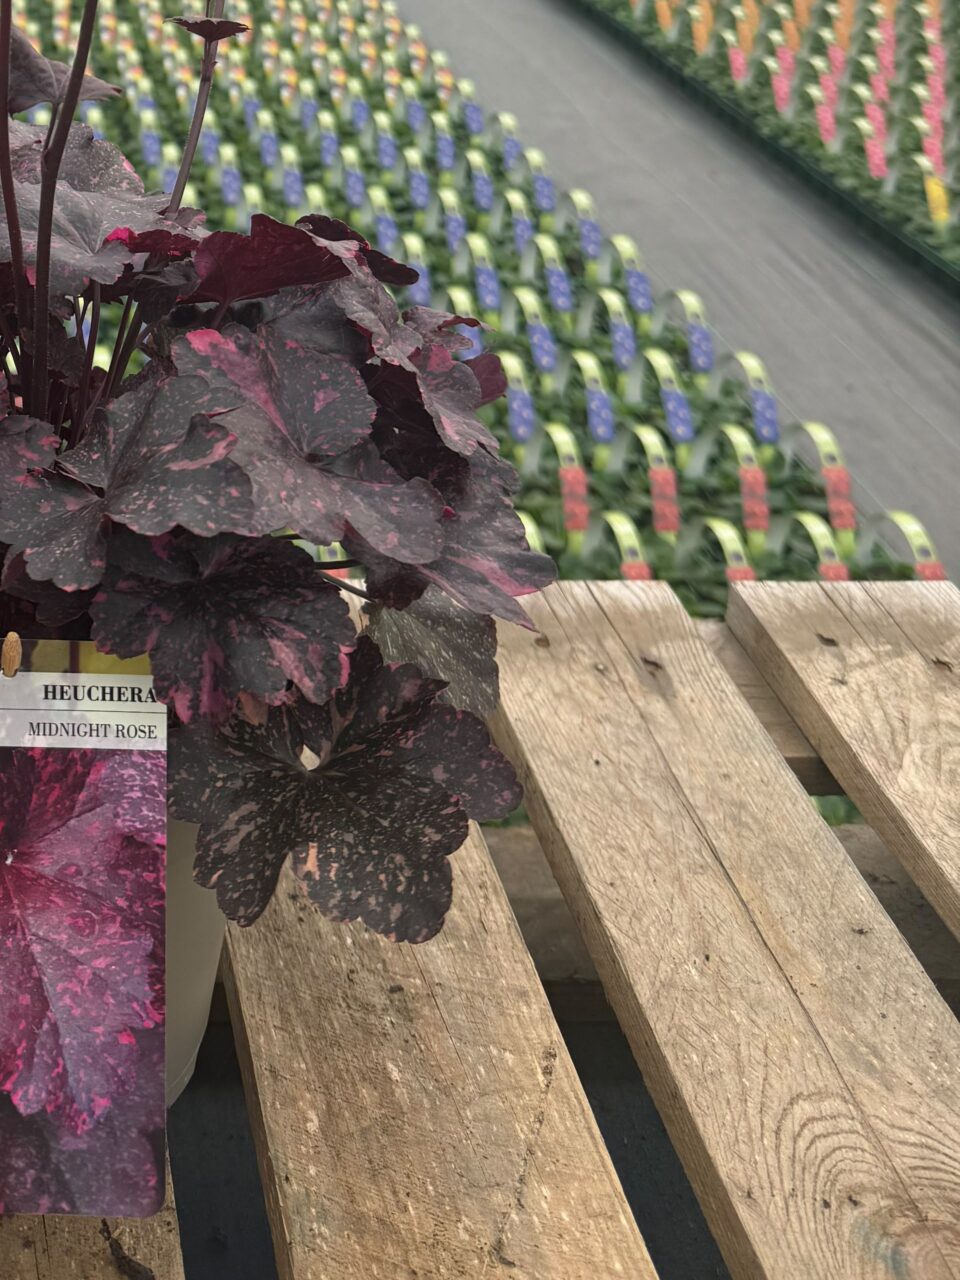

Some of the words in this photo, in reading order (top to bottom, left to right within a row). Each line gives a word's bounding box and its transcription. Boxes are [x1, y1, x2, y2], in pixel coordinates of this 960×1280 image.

[42, 684, 158, 704] HEUCHERA
[28, 721, 111, 738] MIDNIGHT
[115, 723, 158, 740] ROSE
